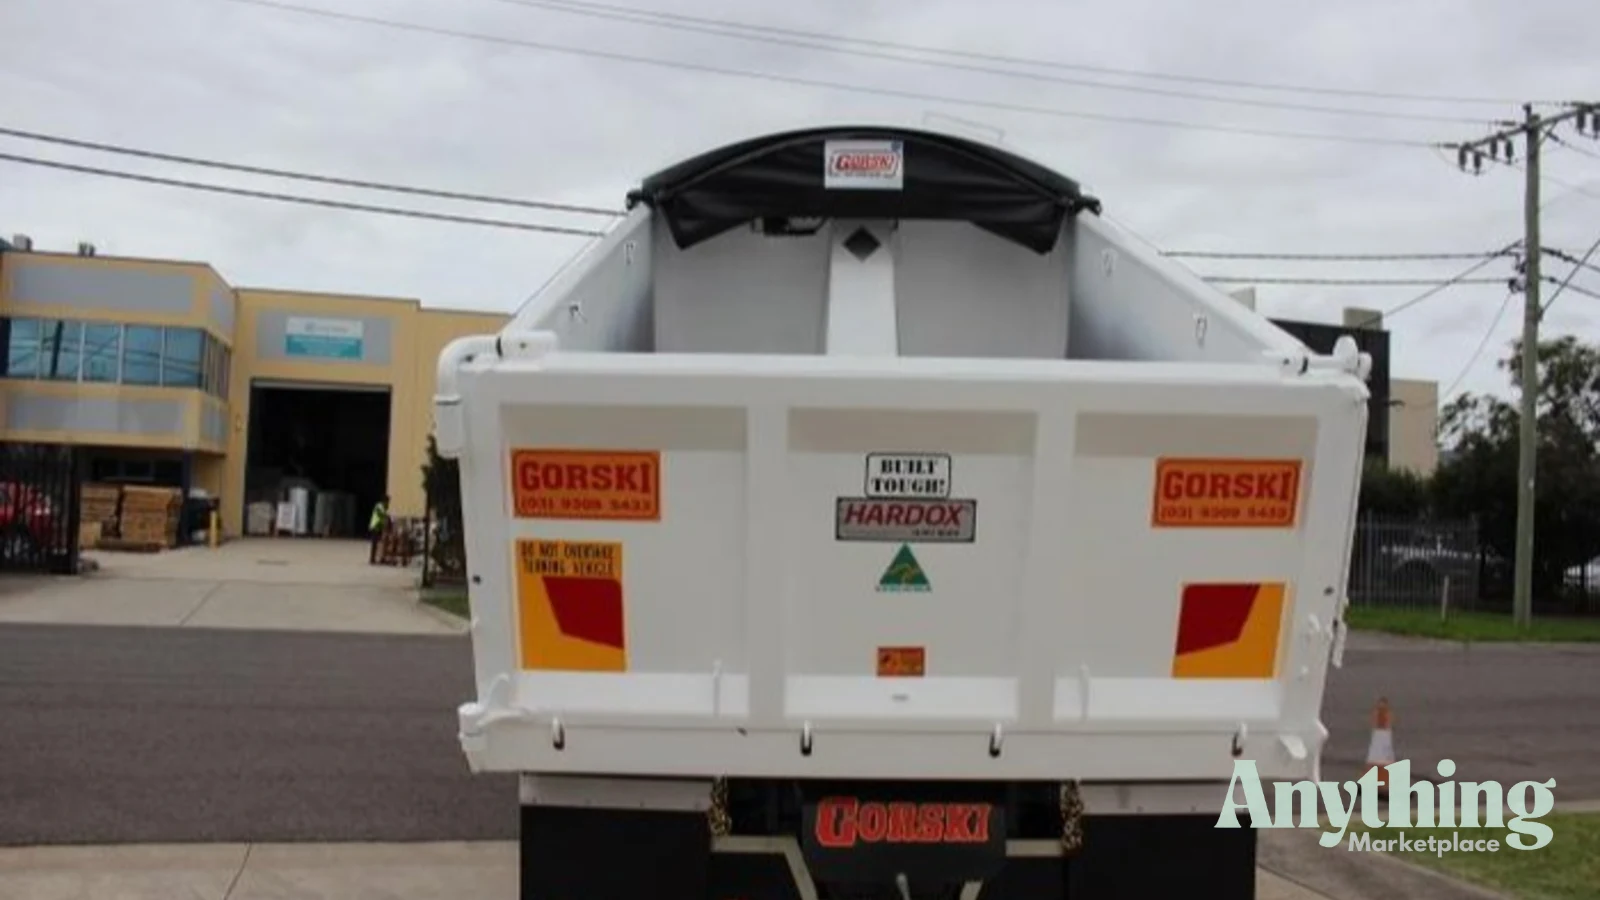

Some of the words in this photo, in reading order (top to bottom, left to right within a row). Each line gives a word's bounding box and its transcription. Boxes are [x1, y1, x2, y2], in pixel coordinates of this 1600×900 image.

[520, 461, 651, 494] GORSKI
[881, 459, 938, 475] BUILT
[871, 478, 946, 493] TOUGH!
[1163, 470, 1292, 501] GORSKI
[844, 502, 964, 527] HARDOX
[520, 541, 534, 557] DO
[539, 541, 559, 558] NOT
[564, 542, 614, 560] OVERTAKE
[524, 558, 566, 574] TURNING
[572, 560, 614, 576] VEHICLE
[816, 797, 992, 847] GORSKI
